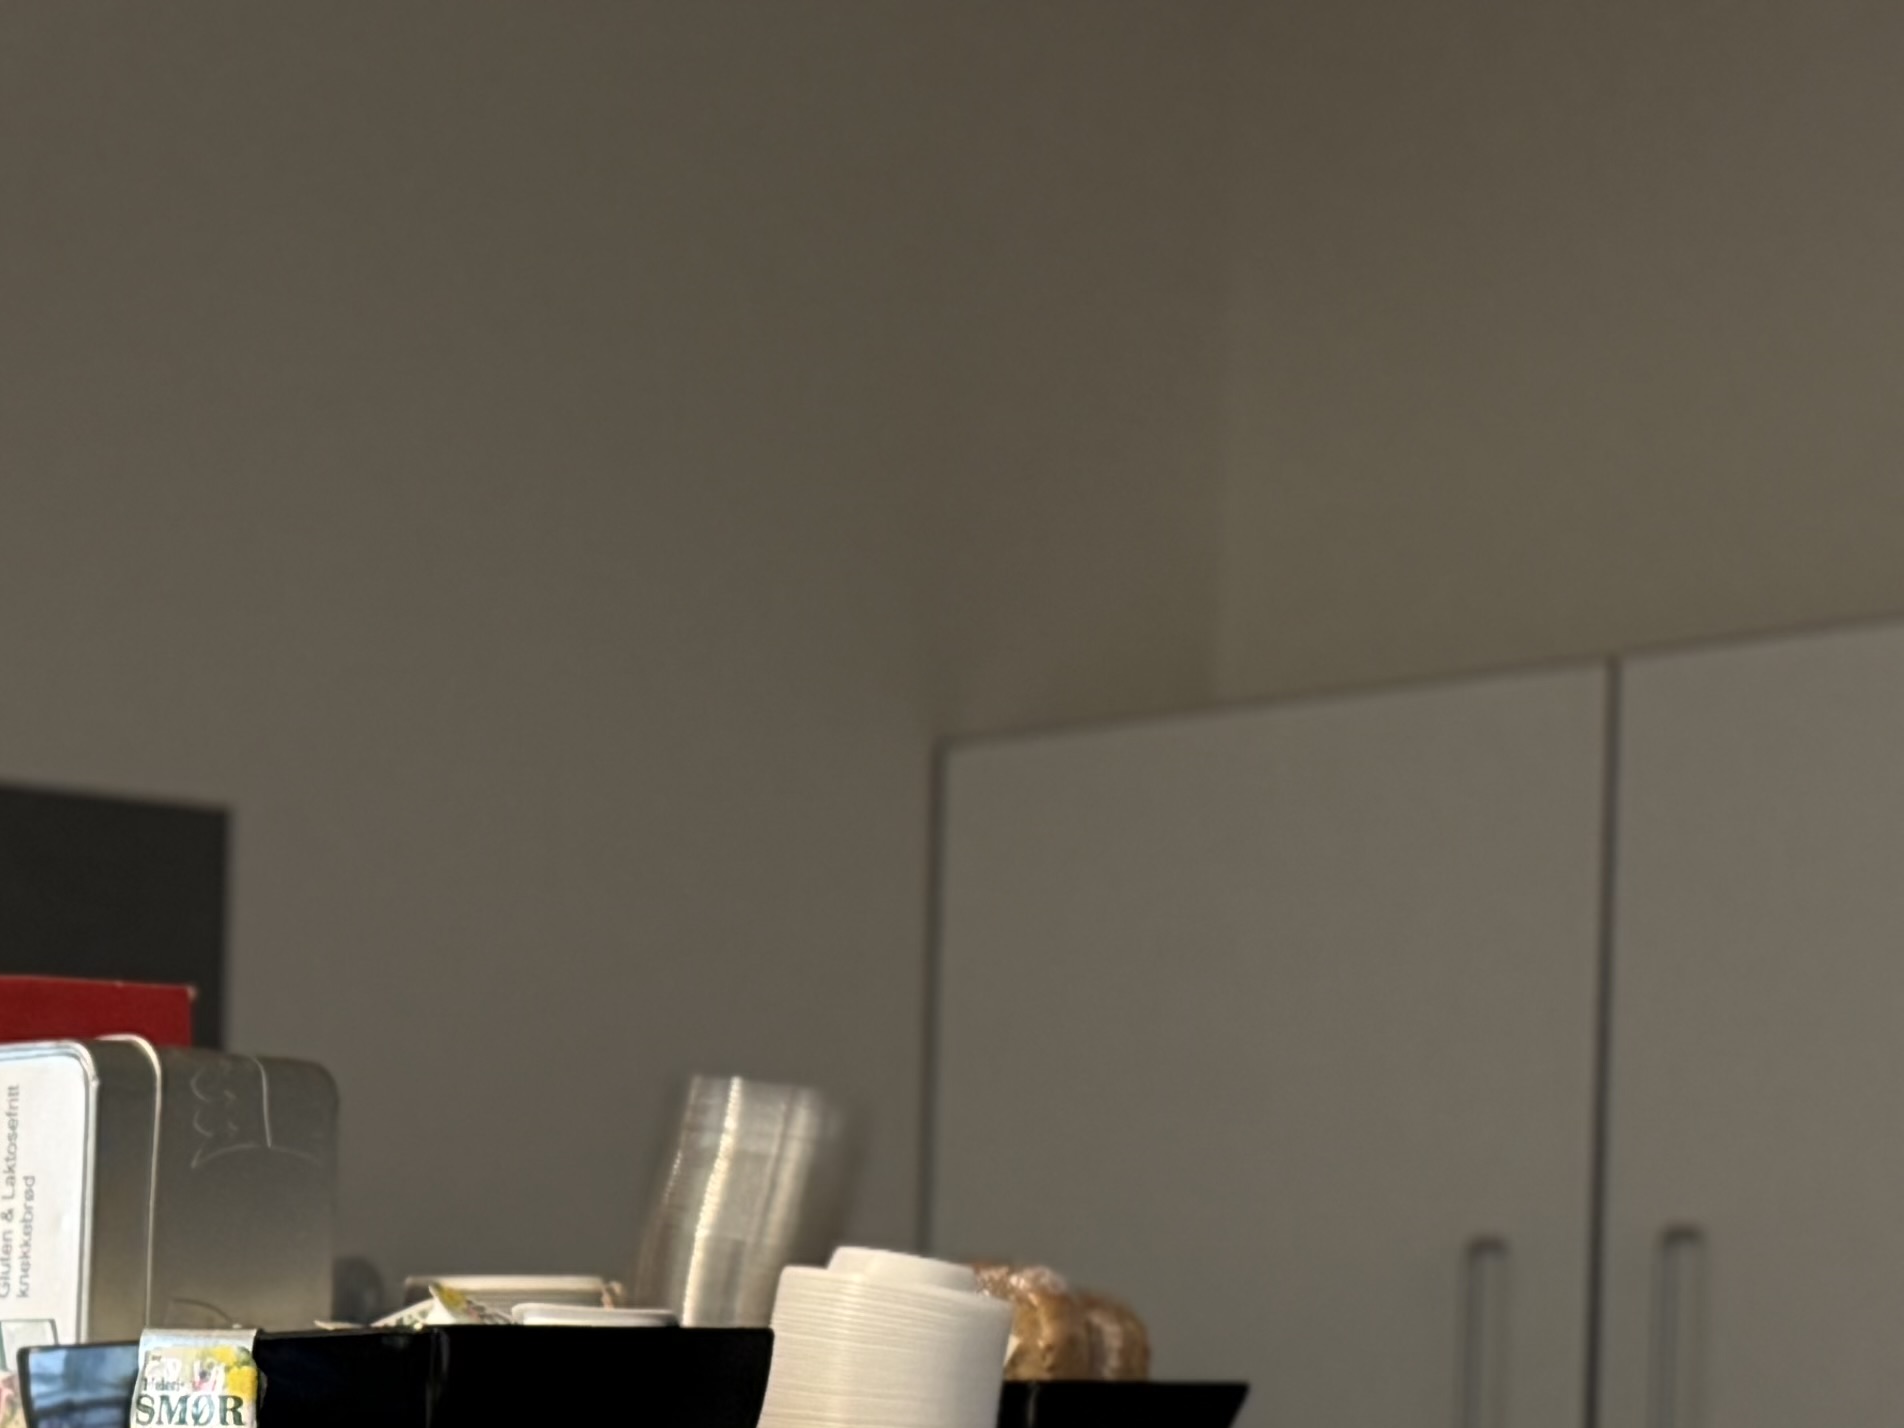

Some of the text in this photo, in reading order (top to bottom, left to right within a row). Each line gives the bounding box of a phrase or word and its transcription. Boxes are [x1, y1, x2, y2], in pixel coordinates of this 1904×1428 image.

[1, 1084, 20, 1200] Laktosefritt
[0, 1208, 14, 1222] &
[135, 1394, 247, 1426] SMØR
